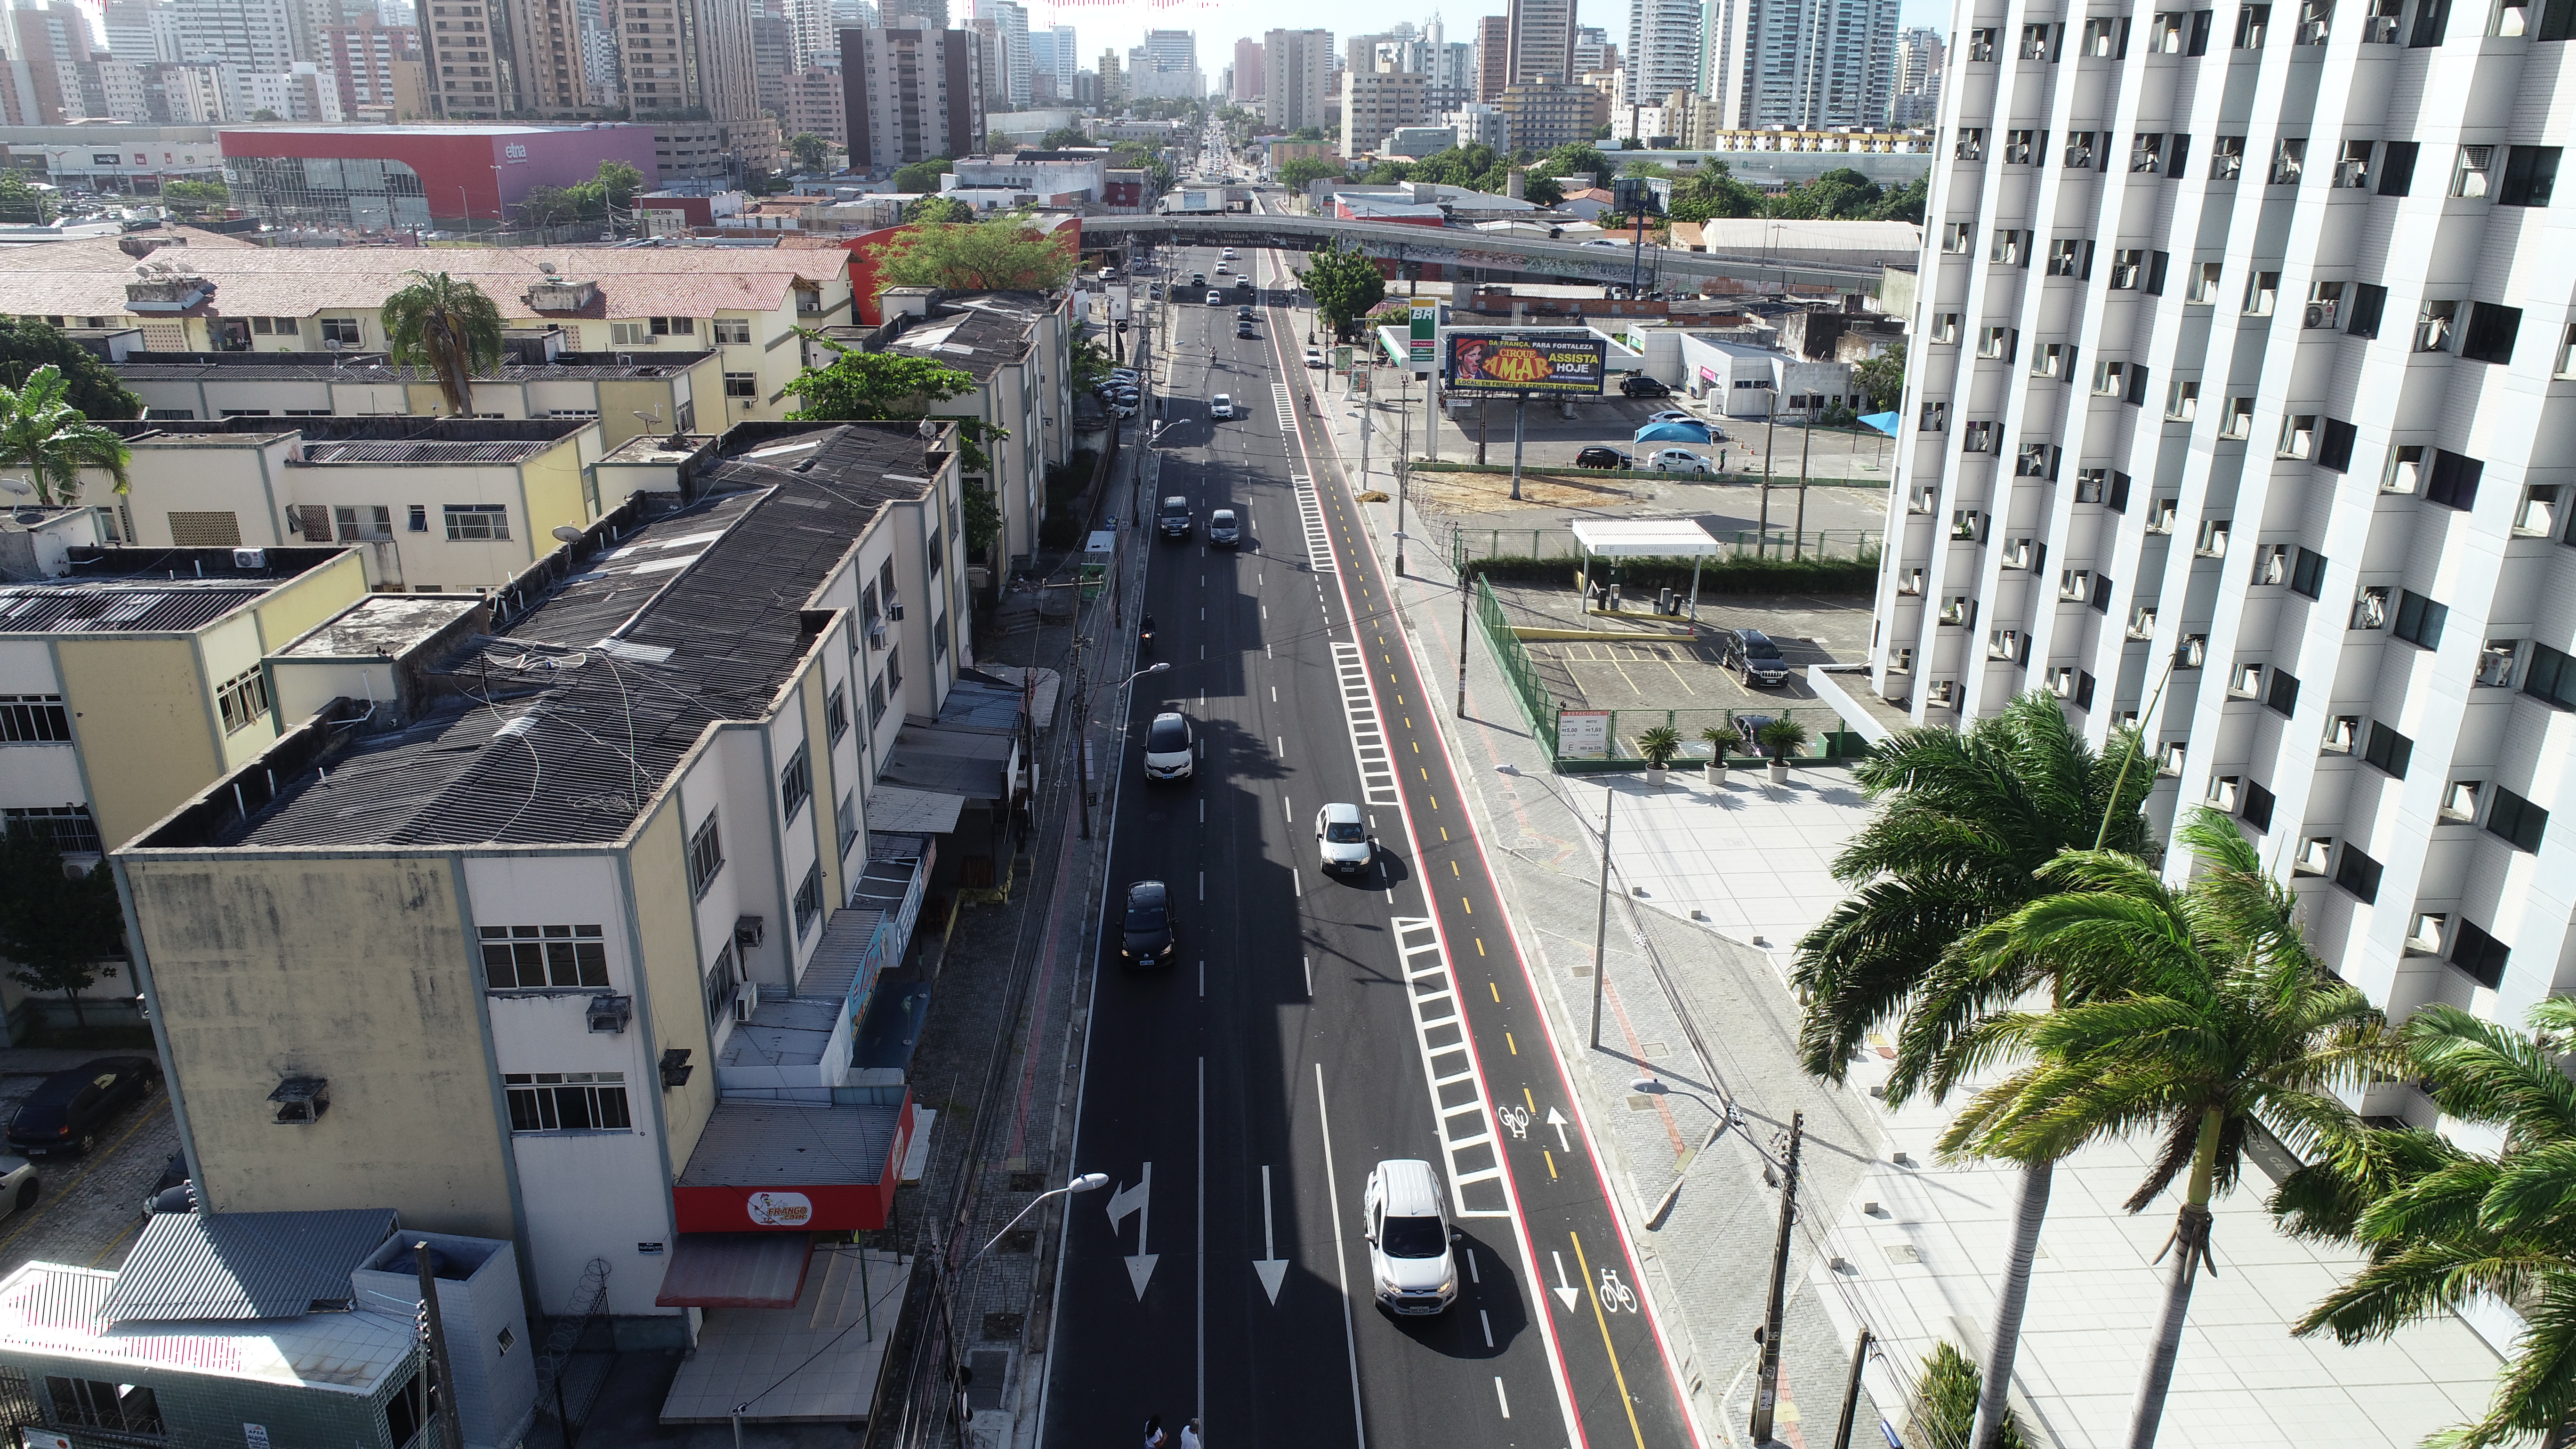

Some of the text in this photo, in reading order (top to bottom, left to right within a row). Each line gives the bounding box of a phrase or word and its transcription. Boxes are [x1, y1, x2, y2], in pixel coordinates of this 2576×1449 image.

[506, 143, 526, 158] etna
[1412, 309, 1433, 320] BR
[1499, 349, 1536, 359] CIRQUE
[1548, 353, 1599, 364] ASSISTA
[1483, 356, 1552, 380] AMAR
[1556, 363, 1589, 373] HOJE
[768, 1207, 808, 1216] FRANGO
